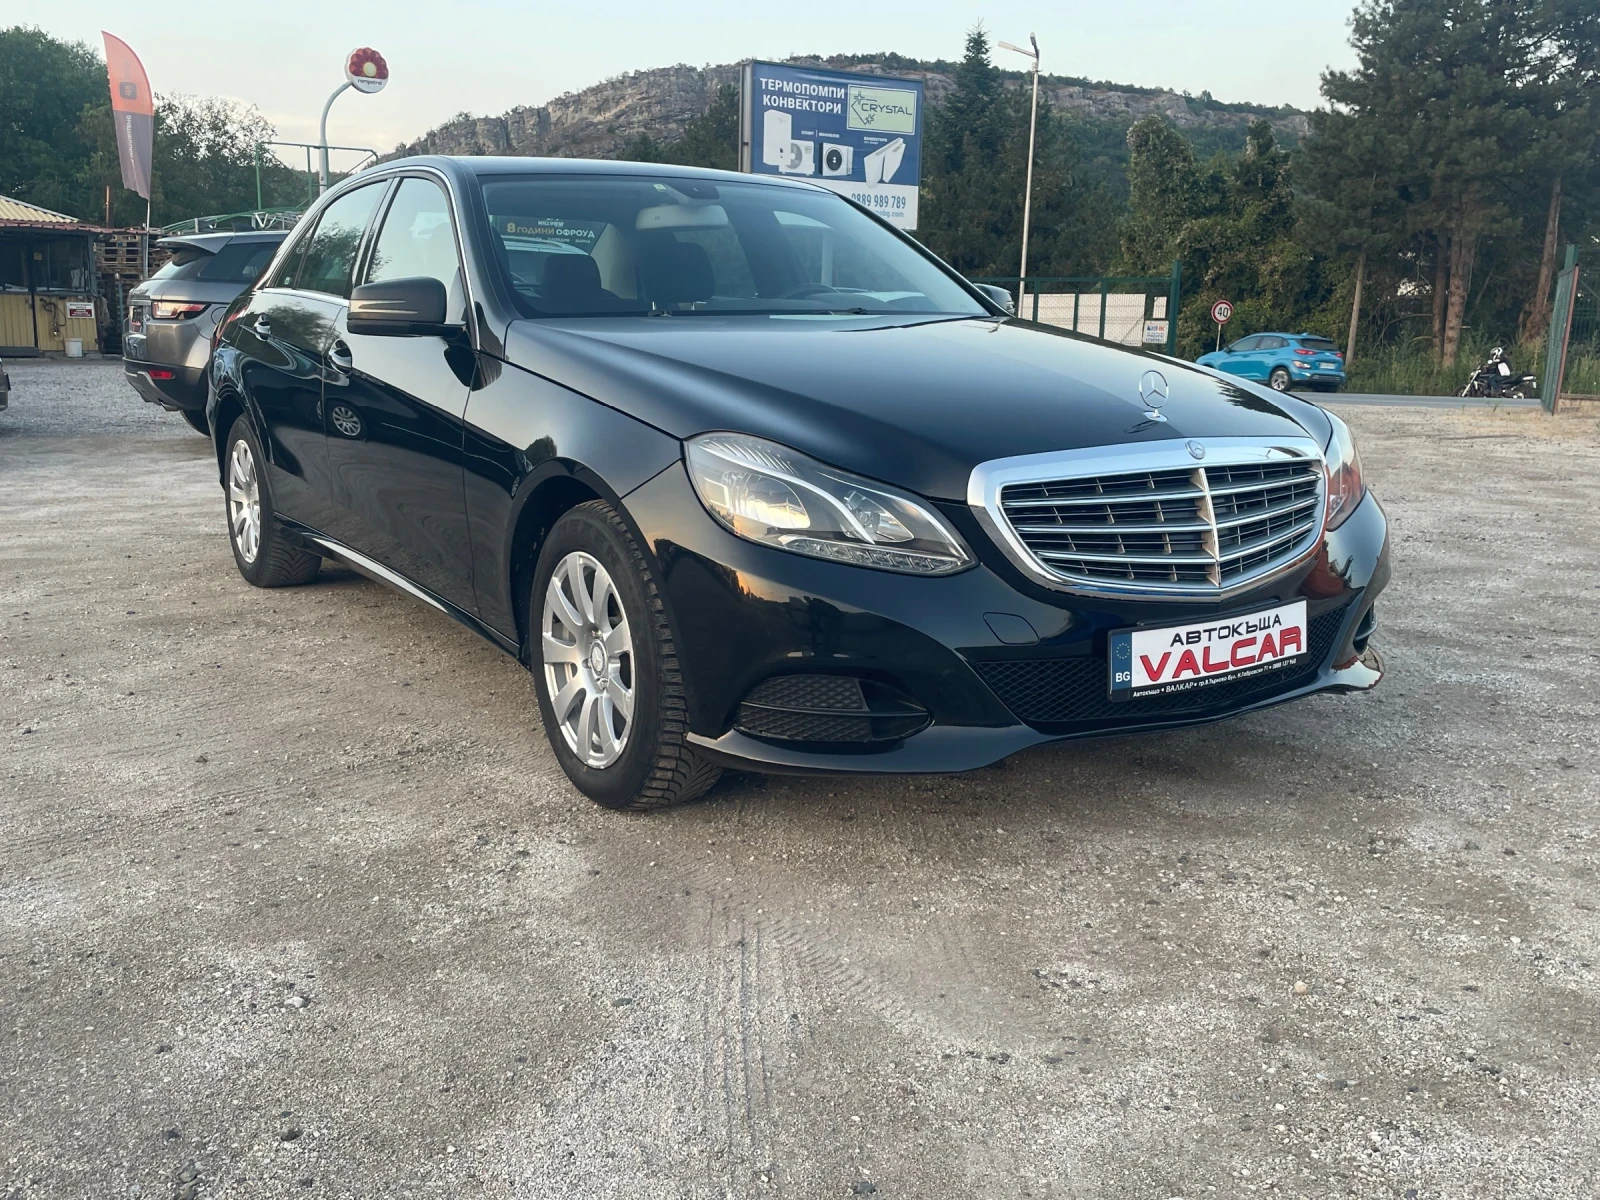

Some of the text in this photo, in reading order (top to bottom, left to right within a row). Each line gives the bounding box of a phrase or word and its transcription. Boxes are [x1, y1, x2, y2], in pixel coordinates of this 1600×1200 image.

[760, 78, 845, 99] ТЕРМОПОМПИ
[763, 94, 842, 114] КОНВЕКТОРИ
[861, 102, 913, 116] CRYSTAL
[874, 194, 889, 208] 989
[891, 195, 906, 209] 789
[506, 222, 595, 239] 8 ГОДИНИ ОФРОУД
[1217, 306, 1229, 318] 40
[1170, 613, 1282, 648] АВТОКЪЩА
[1139, 625, 1302, 682] VALCAR
[1115, 671, 1131, 683] BG
[1166, 681, 1194, 693] ВАЛКАР
